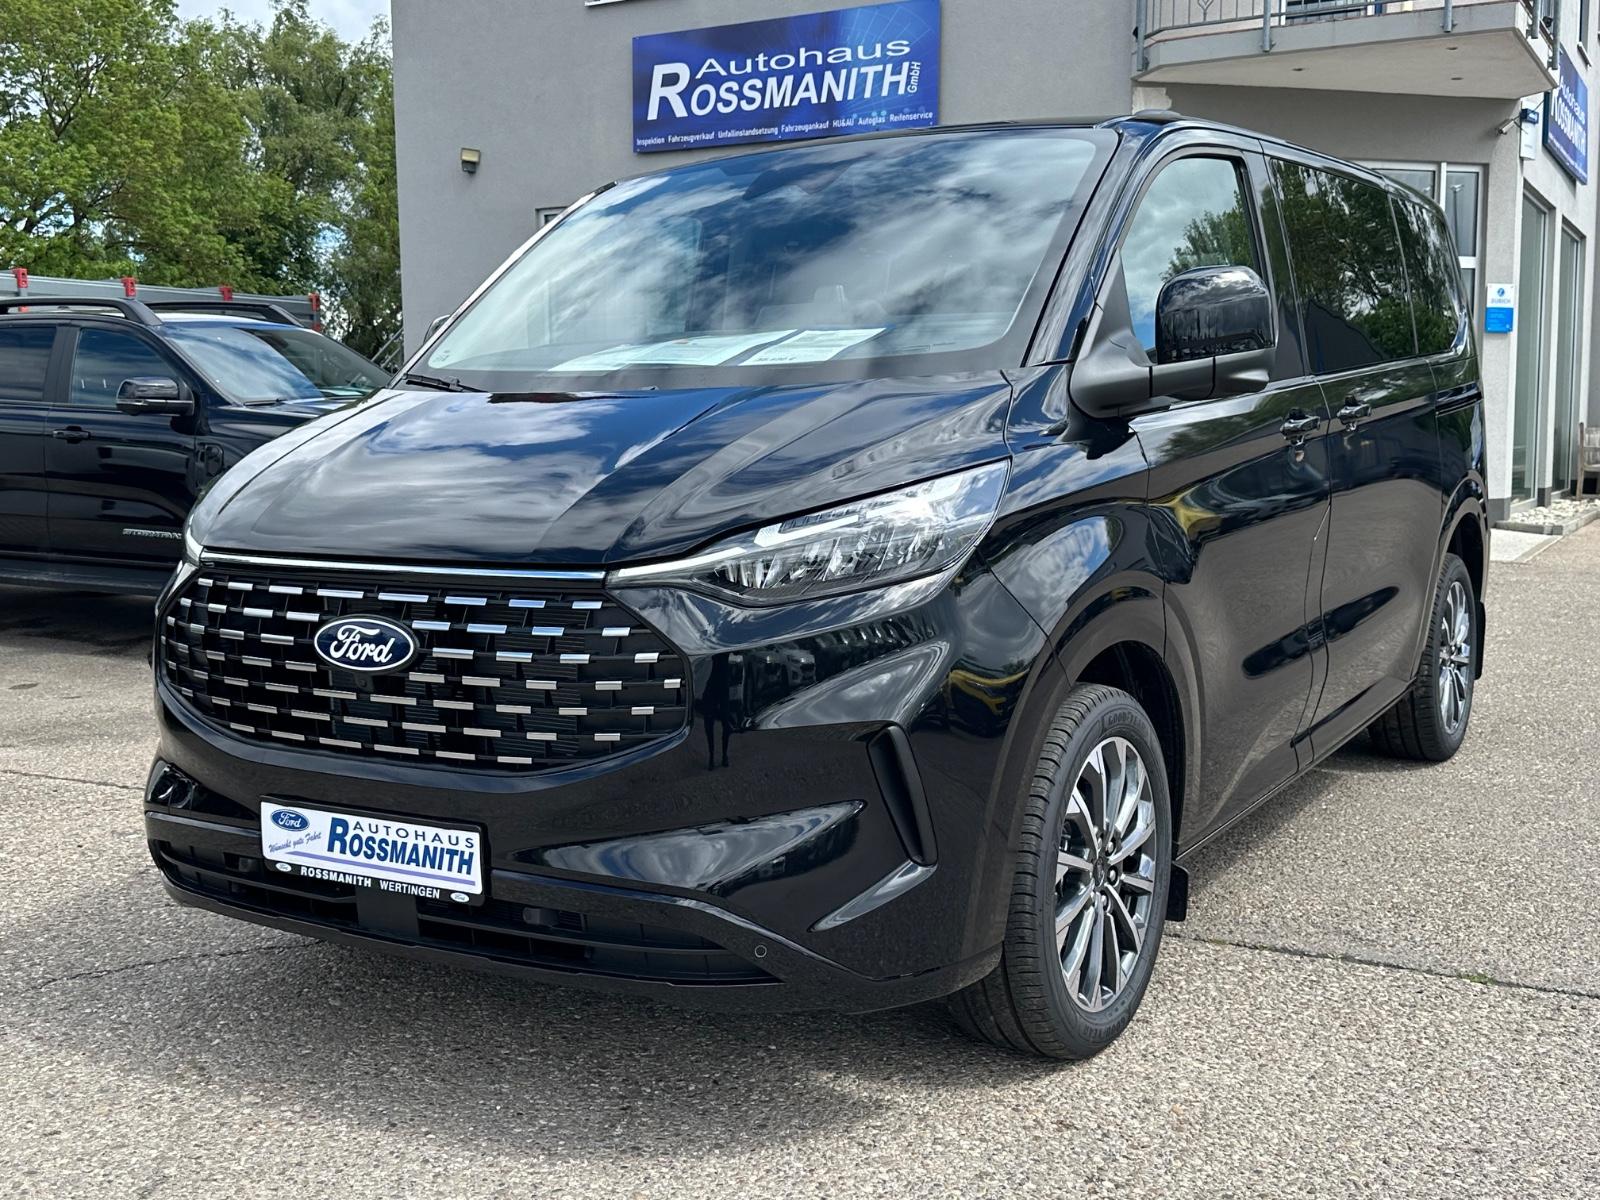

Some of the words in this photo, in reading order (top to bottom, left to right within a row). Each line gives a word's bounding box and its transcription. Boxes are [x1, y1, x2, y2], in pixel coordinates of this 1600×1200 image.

[695, 40, 911, 80] Autohaus
[907, 61, 922, 94] GmbH
[647, 61, 910, 121] ROSSMANITH
[636, 137, 665, 147] Inspektion
[668, 131, 715, 143] Fahrzeugverkauf
[718, 126, 778, 138] Unfallinstandsetzung
[781, 120, 829, 133] Fahrzeugankauf
[832, 117, 854, 128] HU&AU
[858, 115, 886, 127] Autoglas
[889, 111, 934, 123] Reifenservice
[330, 624, 396, 662] Ford
[278, 811, 302, 828] Ford
[353, 821, 475, 848] AUTOHAUS
[327, 817, 475, 875] ROSSMANITH
[300, 866, 372, 888] ROSSMANITH
[379, 879, 440, 899] WERTINGEN
